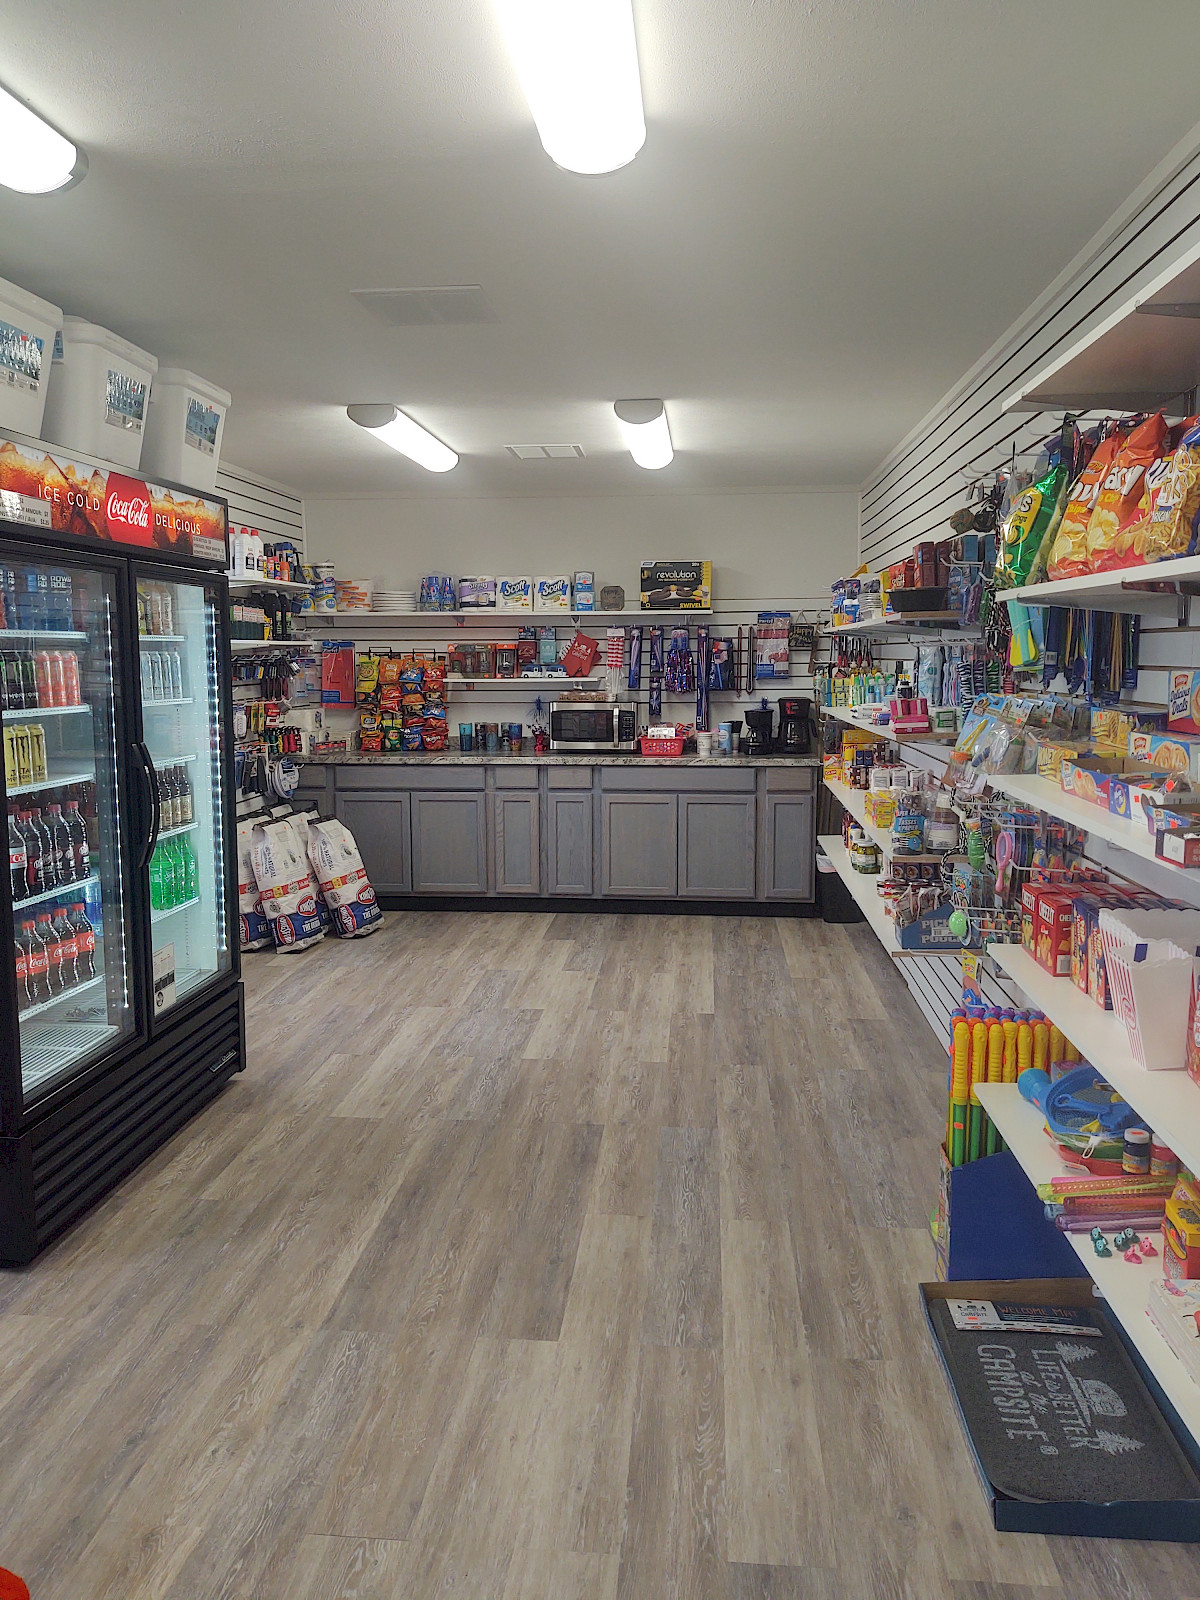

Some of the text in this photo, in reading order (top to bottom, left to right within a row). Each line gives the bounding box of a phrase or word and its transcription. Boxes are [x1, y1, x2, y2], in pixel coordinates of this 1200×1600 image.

[38, 484, 100, 511] ICE COLD
[107, 491, 150, 528] Coca-Cola
[155, 513, 201, 535] DELICIOUS
[656, 569, 697, 579] revolution
[504, 580, 526, 595] Scott
[542, 580, 564, 595] Scott
[921, 934, 961, 944] POUC
[998, 1304, 1078, 1318] WELCOME MAT
[1031, 1349, 1064, 1380] LIFE
[977, 1344, 1050, 1443] CAMPSITE
[1047, 1392, 1101, 1449] BETTER
